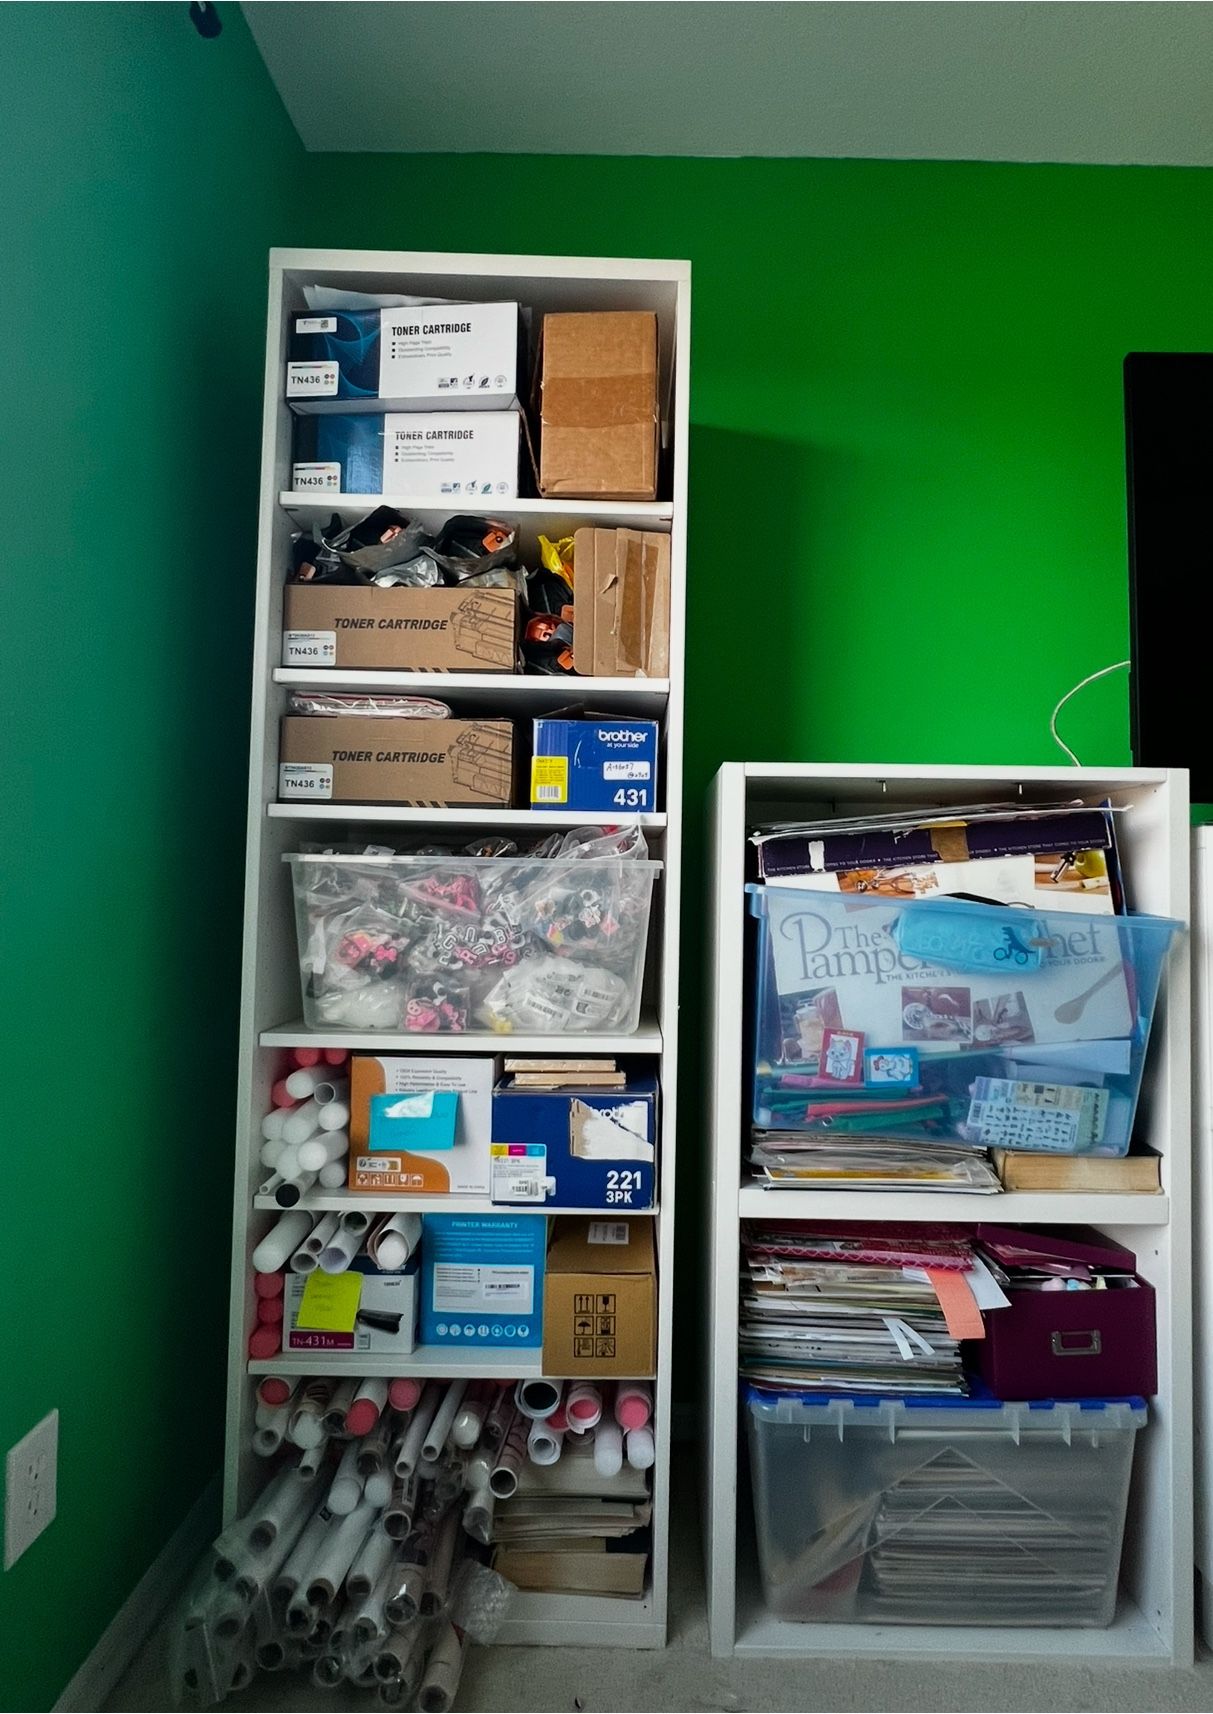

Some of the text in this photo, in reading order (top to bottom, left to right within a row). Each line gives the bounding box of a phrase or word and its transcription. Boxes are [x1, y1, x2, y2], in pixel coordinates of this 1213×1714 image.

[392, 323, 471, 336] TONER CARTRIDGE
[291, 376, 321, 384] TN436
[395, 430, 474, 440] TONER CARTRIDGE
[294, 477, 324, 485] TN436
[335, 618, 448, 630] TONER CARTRIDGE
[289, 647, 318, 656] TN436
[598, 729, 648, 742] brother
[332, 750, 446, 763] TONER CARTRIDGE
[285, 779, 314, 788] TN436
[614, 789, 647, 806] 431
[834, 925, 882, 949] The
[779, 911, 932, 985] Pampe
[1041, 917, 1102, 958] hef
[606, 1170, 642, 1190] 221
[606, 1191, 633, 1203] 3PK
[481, 1221, 518, 1229] WARRANTY
